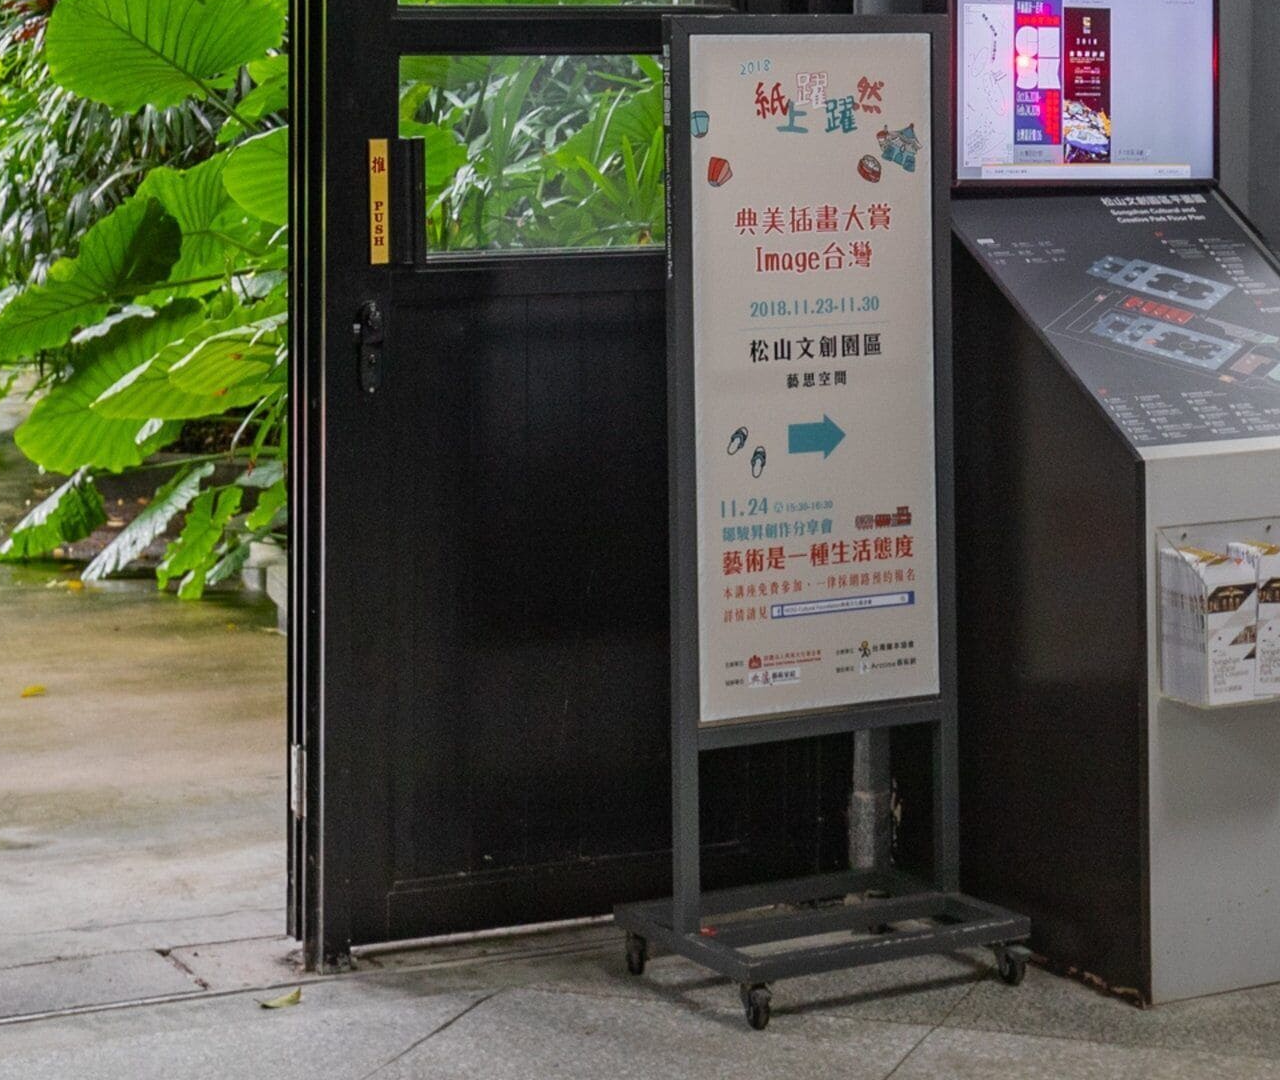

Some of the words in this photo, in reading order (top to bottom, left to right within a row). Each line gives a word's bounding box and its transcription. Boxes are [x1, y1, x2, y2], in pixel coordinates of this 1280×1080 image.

[740, 58, 770, 76] 2018
[372, 156, 385, 173] 推
[374, 201, 384, 246] PUSH
[735, 203, 892, 236] 典美插畫大賞
[755, 241, 873, 273] Image台灣
[750, 295, 880, 318] 2018.11.23-11.30
[749, 333, 882, 363] 松山文創園區
[786, 370, 847, 389] 藝思空間
[721, 498, 768, 518] 11.24
[722, 534, 914, 576] 藝術是一種生活態度
